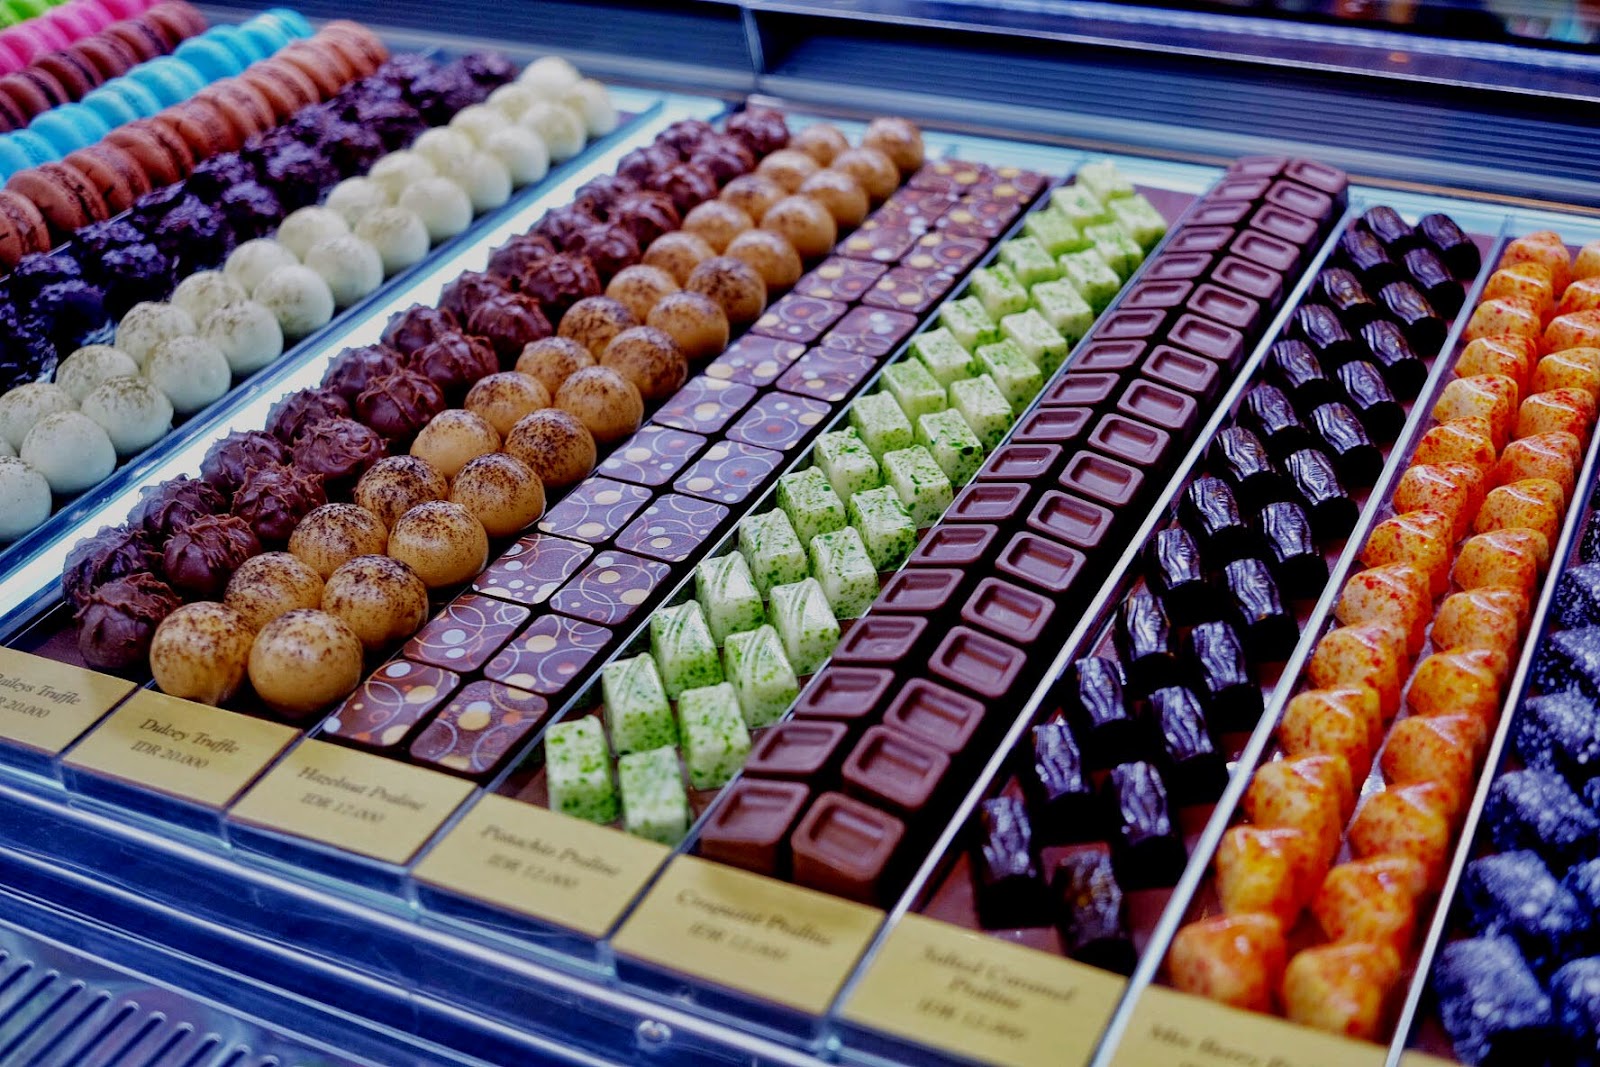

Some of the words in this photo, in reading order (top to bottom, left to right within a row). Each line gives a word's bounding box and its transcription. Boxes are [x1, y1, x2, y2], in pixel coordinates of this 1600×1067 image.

[36, 685, 82, 705] Truffle
[130, 740, 162, 756] IDR
[139, 719, 190, 741] Dulcey
[192, 731, 240, 754] Truffle
[297, 766, 368, 794] Hazelnut
[368, 786, 427, 811] Praline
[300, 792, 333, 808] IDR
[480, 824, 556, 856] Pistachio
[557, 847, 622, 877] Praline
[486, 853, 523, 872] IDR
[765, 913, 832, 947] Praline
